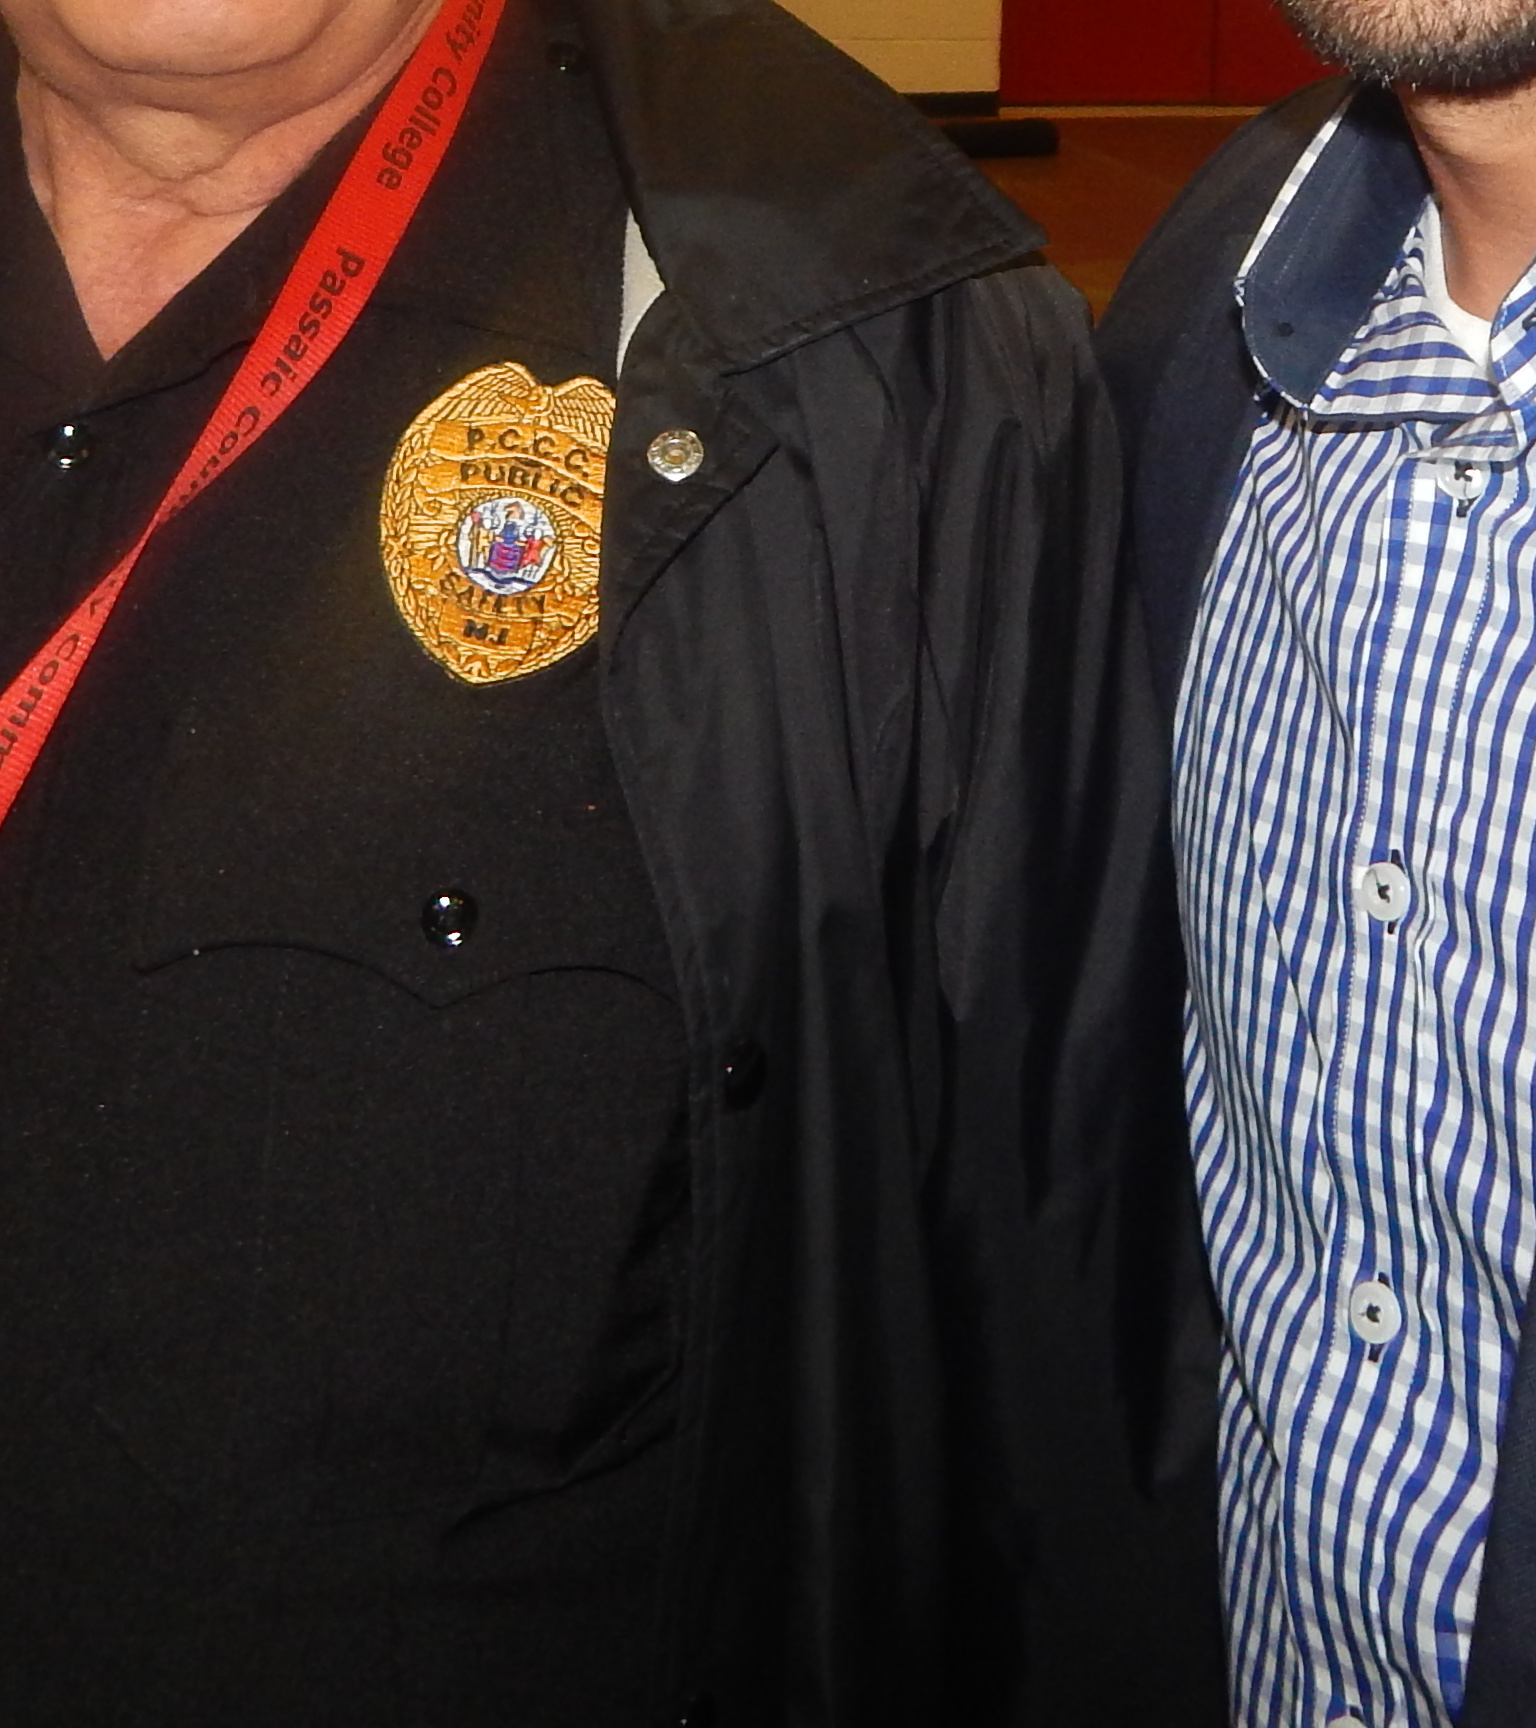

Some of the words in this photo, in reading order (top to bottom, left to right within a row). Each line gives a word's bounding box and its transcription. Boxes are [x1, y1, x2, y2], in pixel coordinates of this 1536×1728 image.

[377, 66, 458, 191] College
[260, 246, 366, 397] Passaic
[460, 462, 586, 509] PUBLIC
